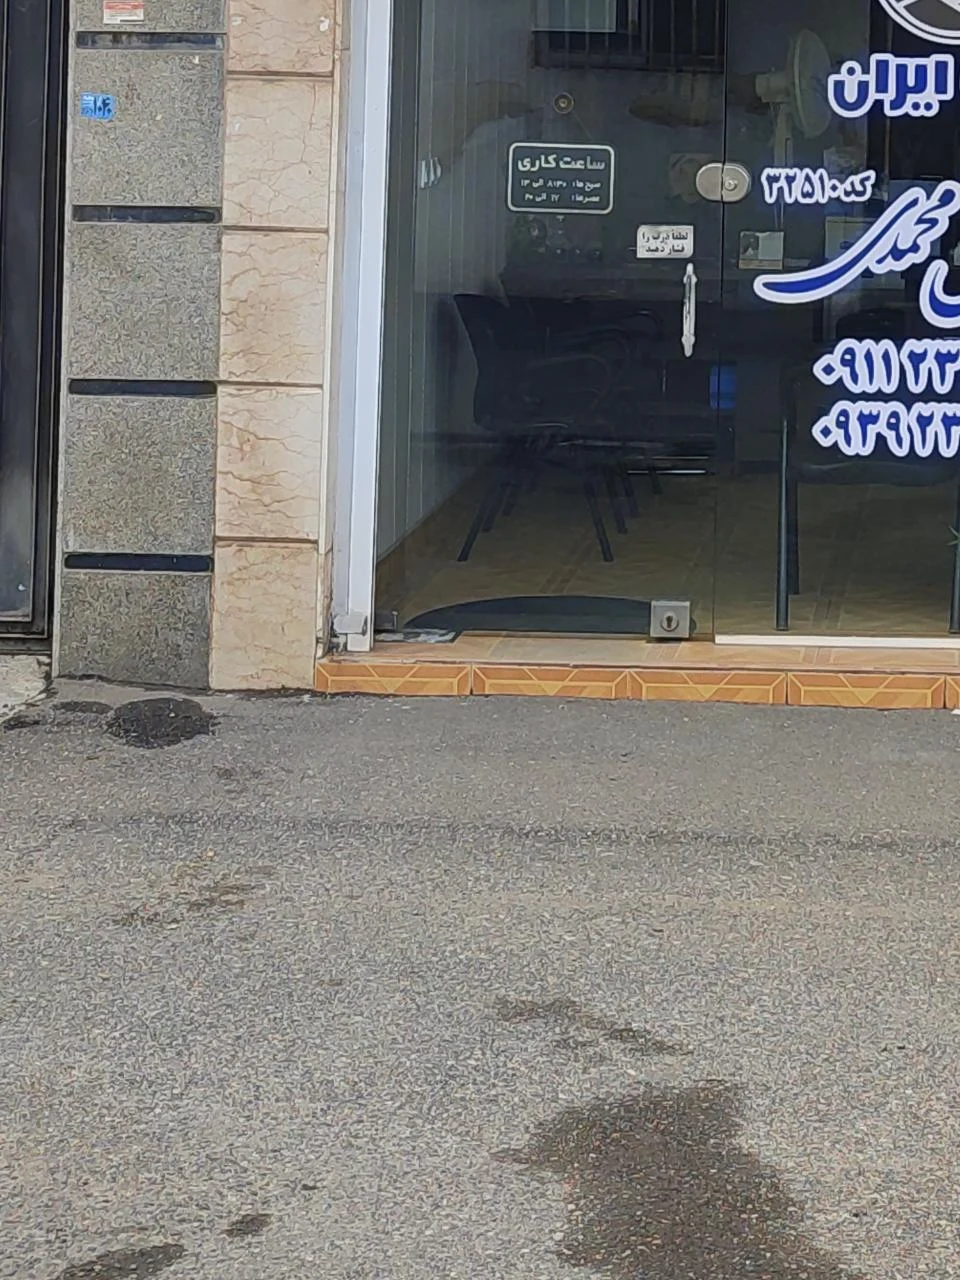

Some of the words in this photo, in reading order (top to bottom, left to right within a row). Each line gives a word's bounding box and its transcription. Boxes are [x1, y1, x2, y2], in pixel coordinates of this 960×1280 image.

[828, 53, 954, 118] ایران
[518, 154, 557, 171] کاری
[560, 155, 605, 170] ساعت
